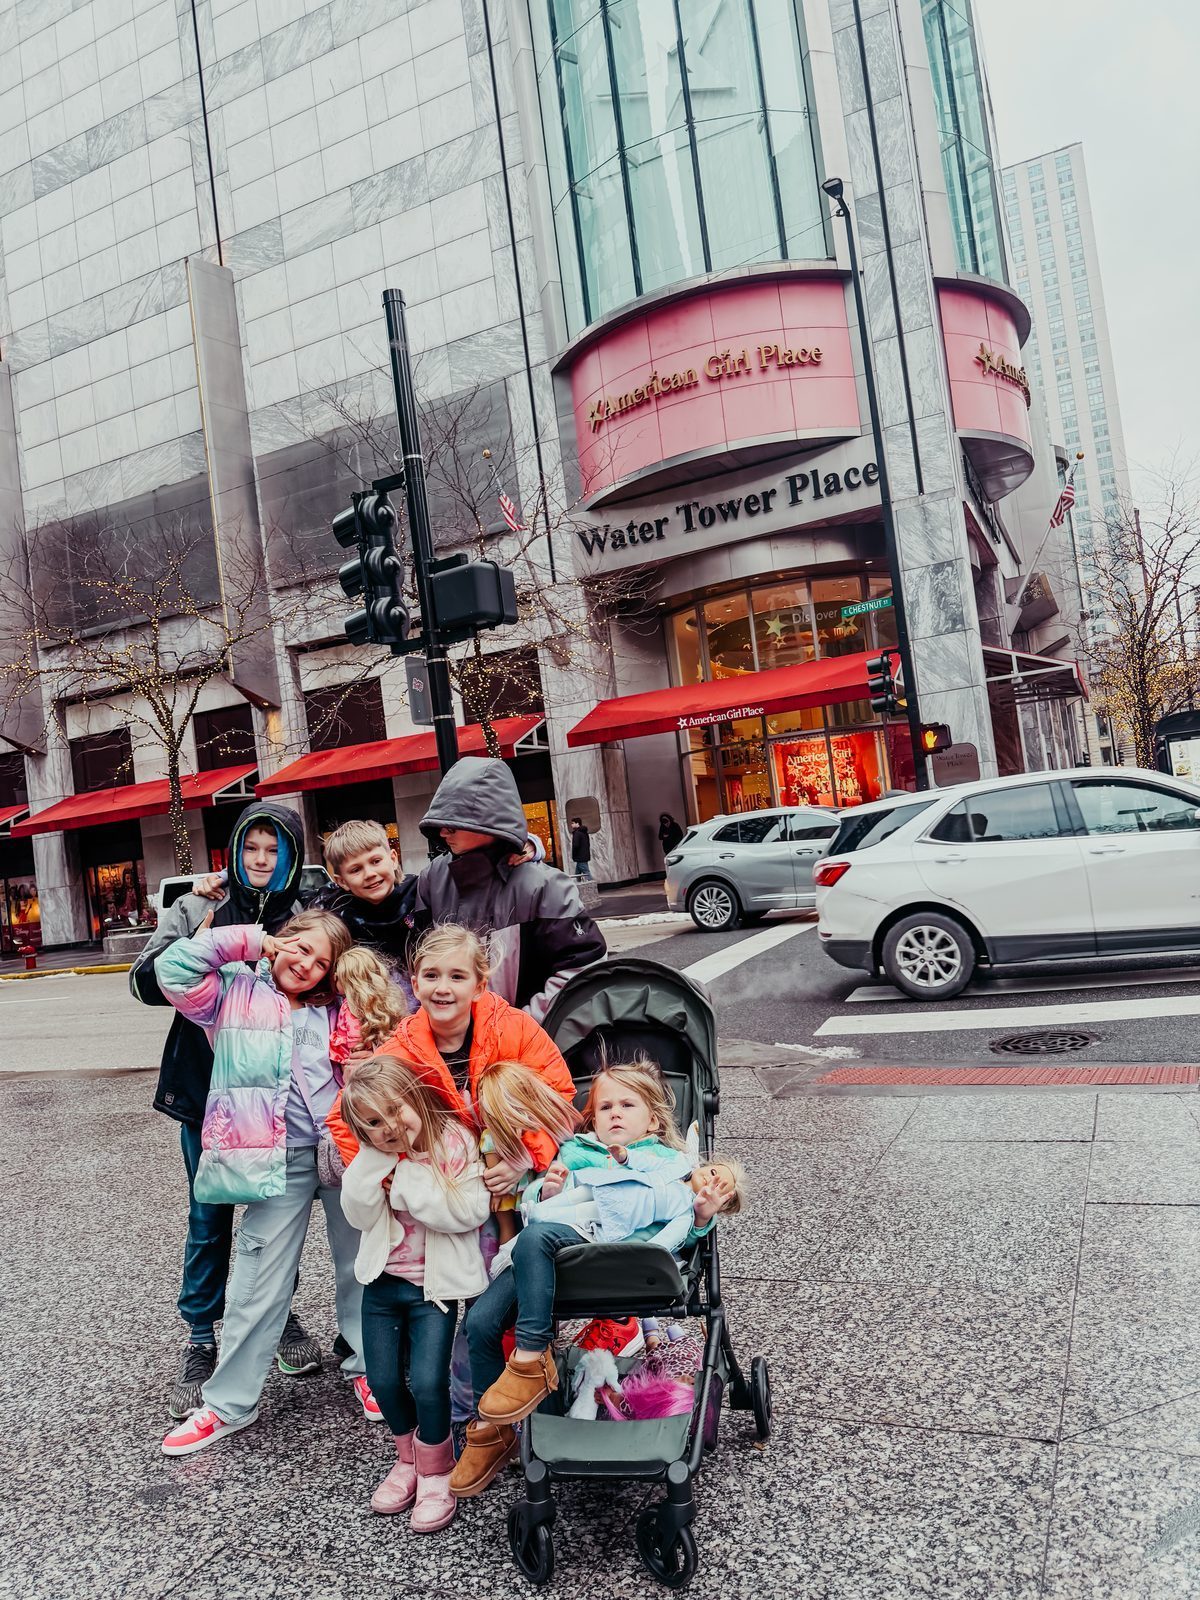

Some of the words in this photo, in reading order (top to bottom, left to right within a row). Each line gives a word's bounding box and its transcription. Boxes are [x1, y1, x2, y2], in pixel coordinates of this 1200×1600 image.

[601, 368, 698, 421] American
[703, 349, 752, 380] Girl
[758, 345, 824, 369] Place
[576, 515, 669, 556] Water
[676, 487, 776, 533] Tower
[785, 462, 880, 506] Place
[848, 600, 882, 615] CHESTNUT
[792, 610, 838, 624] Disover
[688, 712, 727, 726] American
[727, 709, 742, 720] Girl
[742, 707, 764, 717] Place
[834, 748, 852, 759] Girl
